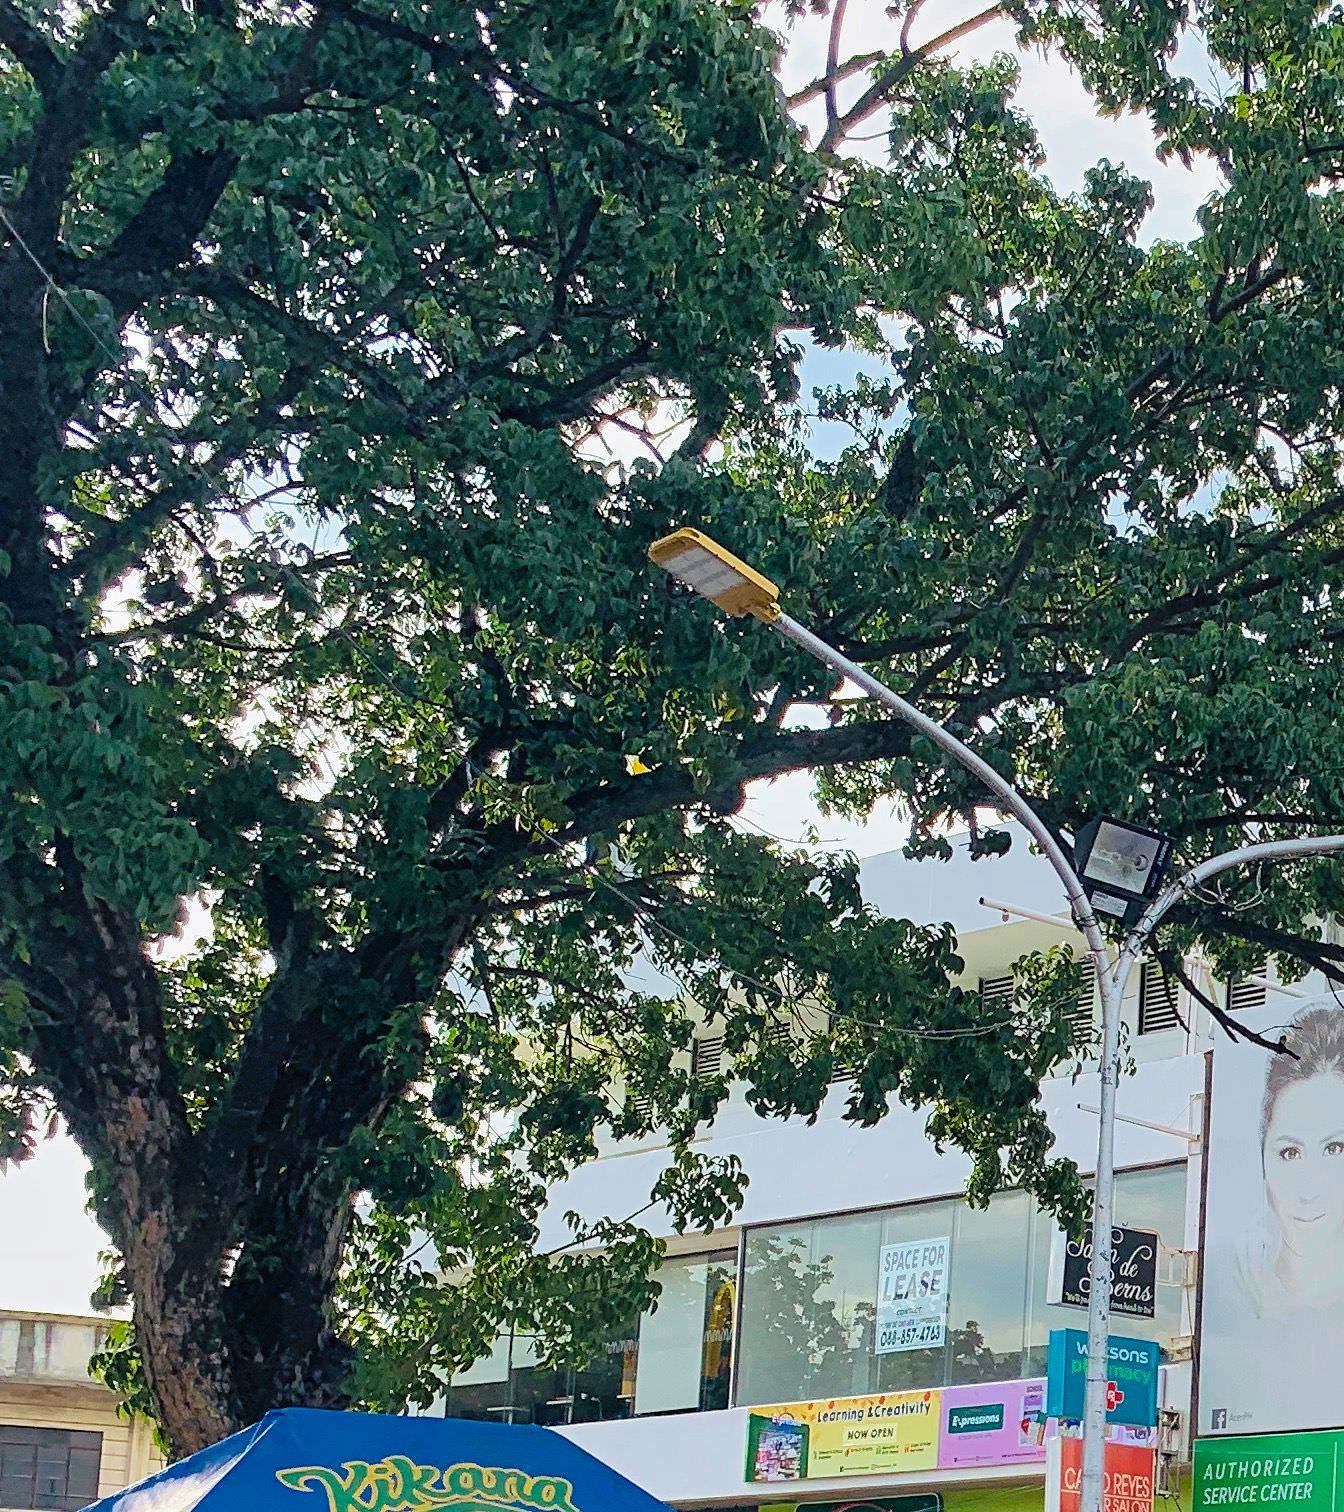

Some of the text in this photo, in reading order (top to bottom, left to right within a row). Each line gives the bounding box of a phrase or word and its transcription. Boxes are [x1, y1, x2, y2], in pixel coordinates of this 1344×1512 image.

[884, 1245, 945, 1272] SPACE FOR
[1119, 1245, 1153, 1278] de
[883, 1269, 943, 1301] LEASE
[817, 1408, 865, 1423] Learning
[847, 1427, 894, 1440] NOW OPEN
[1203, 1456, 1315, 1481] AUTHORIZED
[1113, 1472, 1150, 1498] REYES
[1202, 1482, 1314, 1506] SERVICE CENTER
